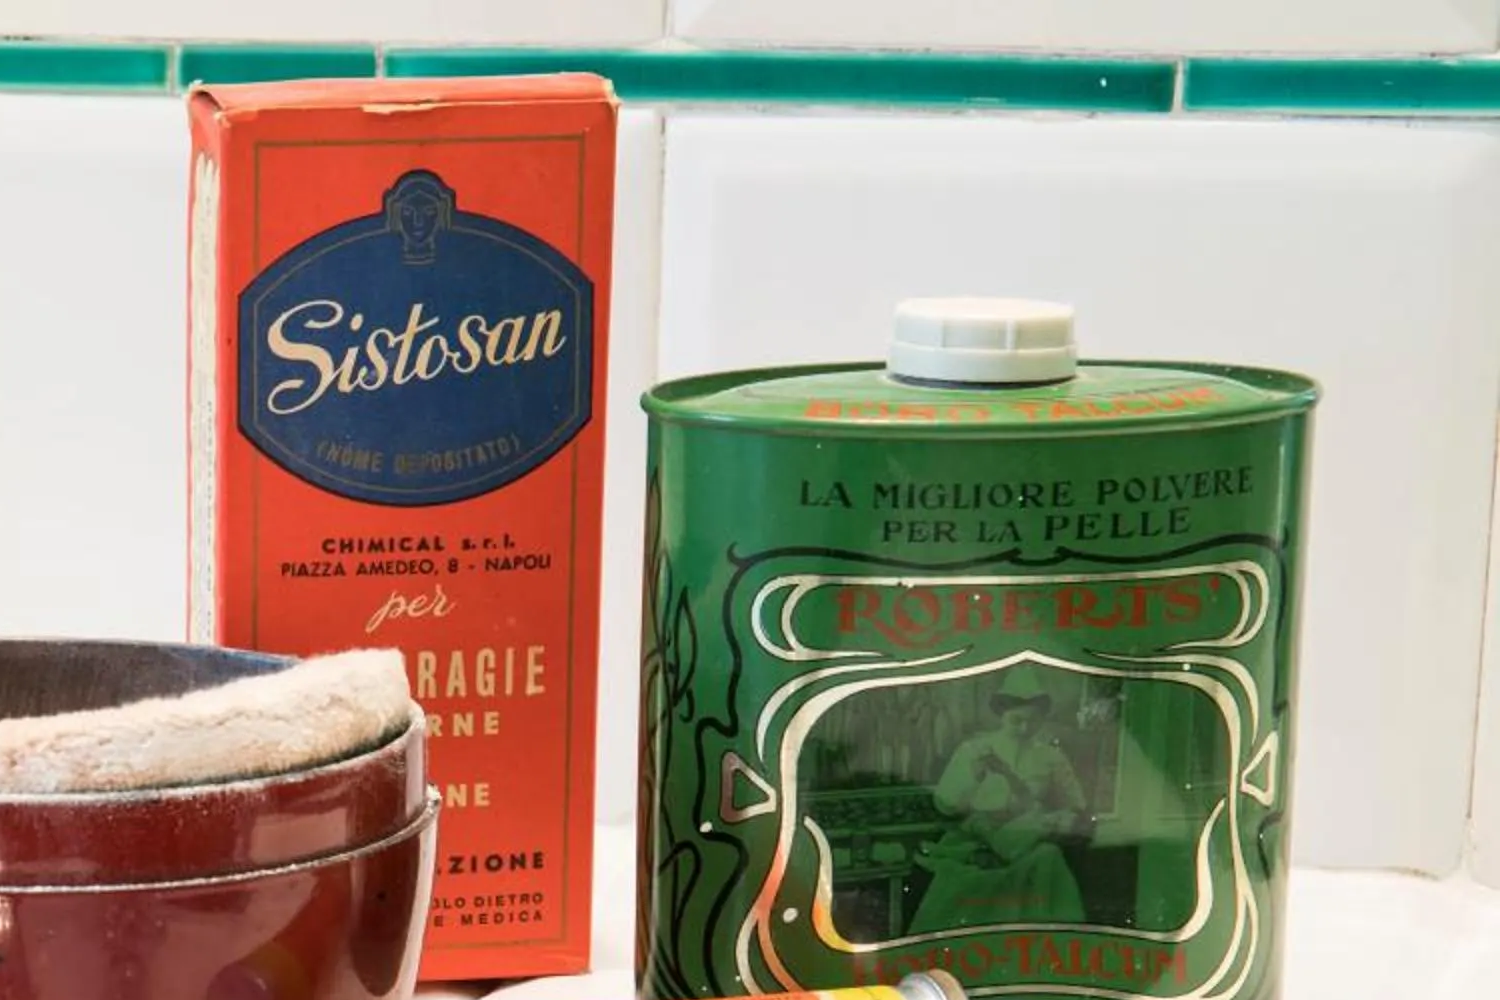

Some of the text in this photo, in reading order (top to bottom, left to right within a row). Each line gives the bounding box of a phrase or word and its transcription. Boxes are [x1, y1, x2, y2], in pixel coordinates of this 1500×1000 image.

[267, 300, 566, 414] Sistosan
[800, 466, 1254, 510] LA MIGLIORE POLVERE
[881, 506, 1192, 543] PER LA PELLE
[321, 536, 445, 554] CHIMICAL
[281, 561, 346, 578] PIAZZA
[356, 558, 439, 577] AMEDEO,
[447, 560, 458, 574] 8
[484, 554, 551, 570] NAPOLI
[365, 584, 455, 633] per
[436, 851, 544, 876] ZIONE
[473, 892, 543, 908] DIETRO
[461, 909, 542, 925] MEDICA
